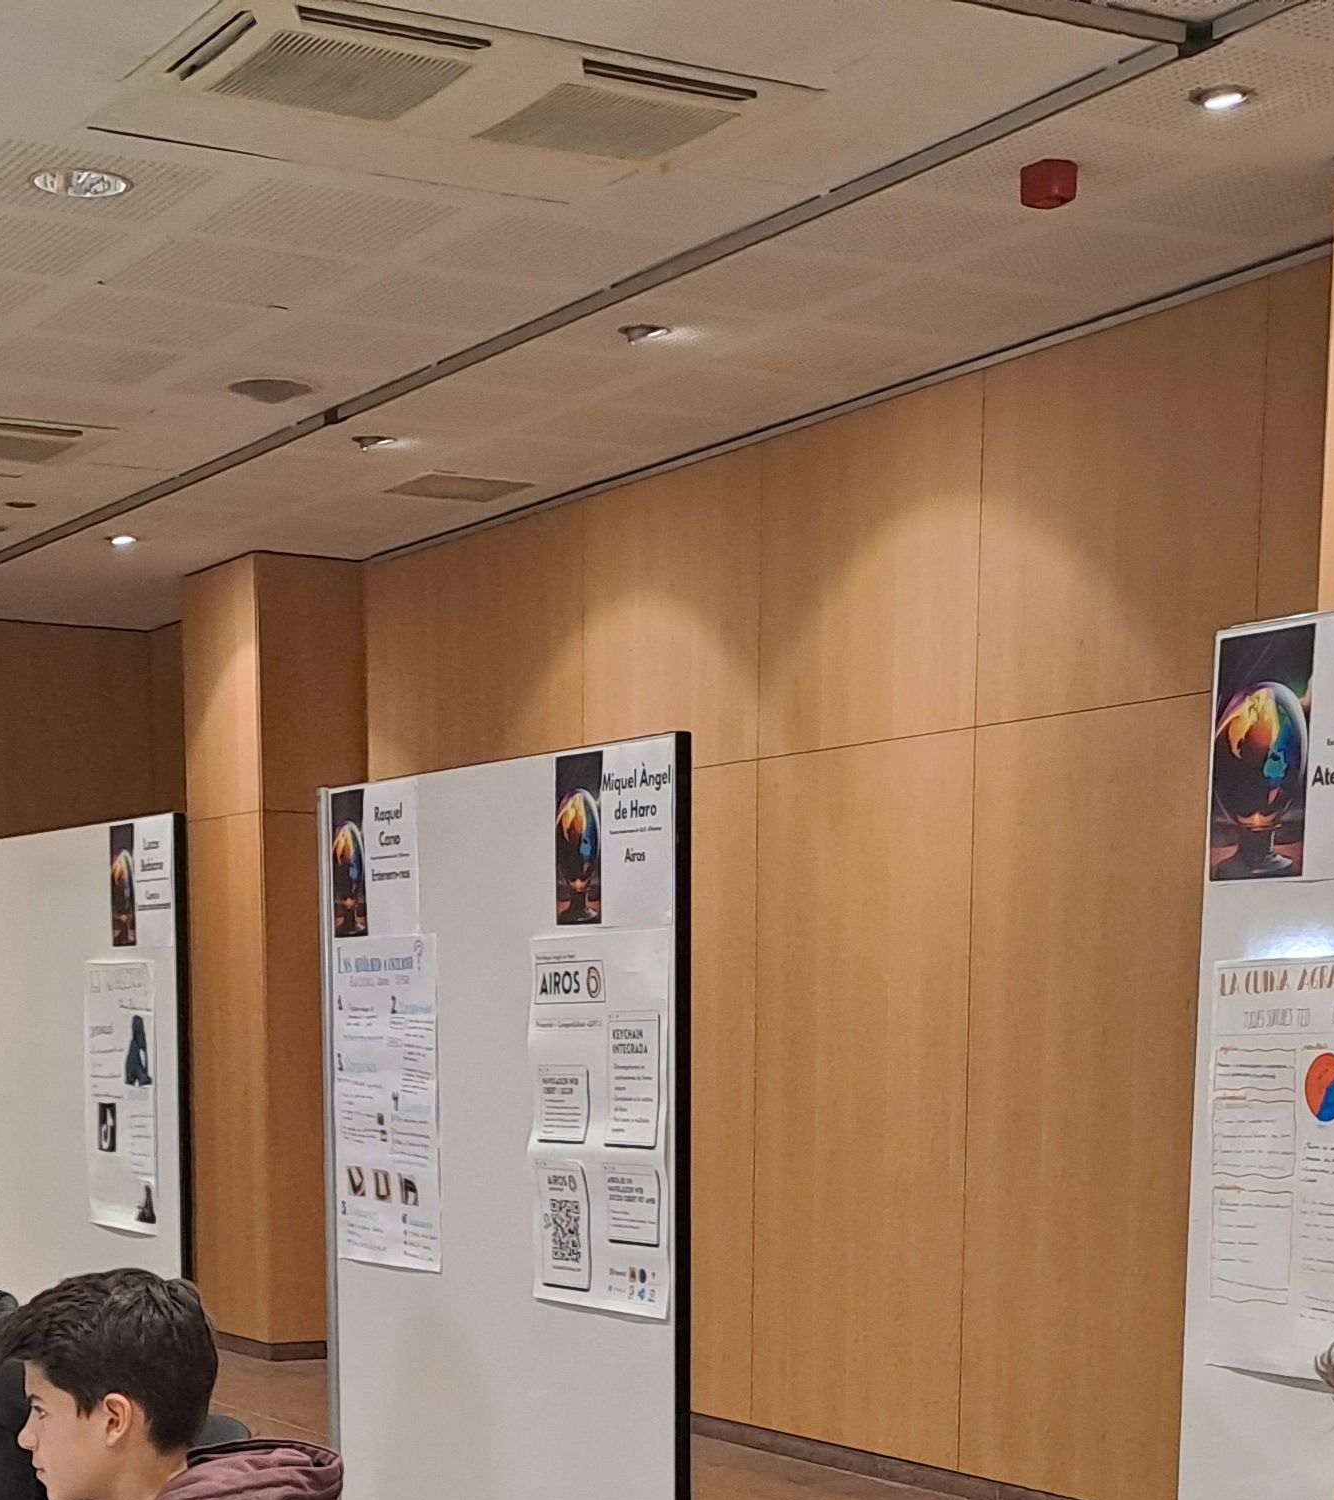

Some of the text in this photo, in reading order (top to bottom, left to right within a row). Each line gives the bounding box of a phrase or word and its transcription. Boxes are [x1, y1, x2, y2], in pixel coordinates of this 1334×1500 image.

[602, 762, 671, 796] Miquel Àngel
[374, 802, 403, 825] Raquel
[614, 799, 657, 820] de Haro
[379, 831, 400, 847] Cano
[624, 847, 646, 863] Airos
[539, 970, 581, 996] AIROS
